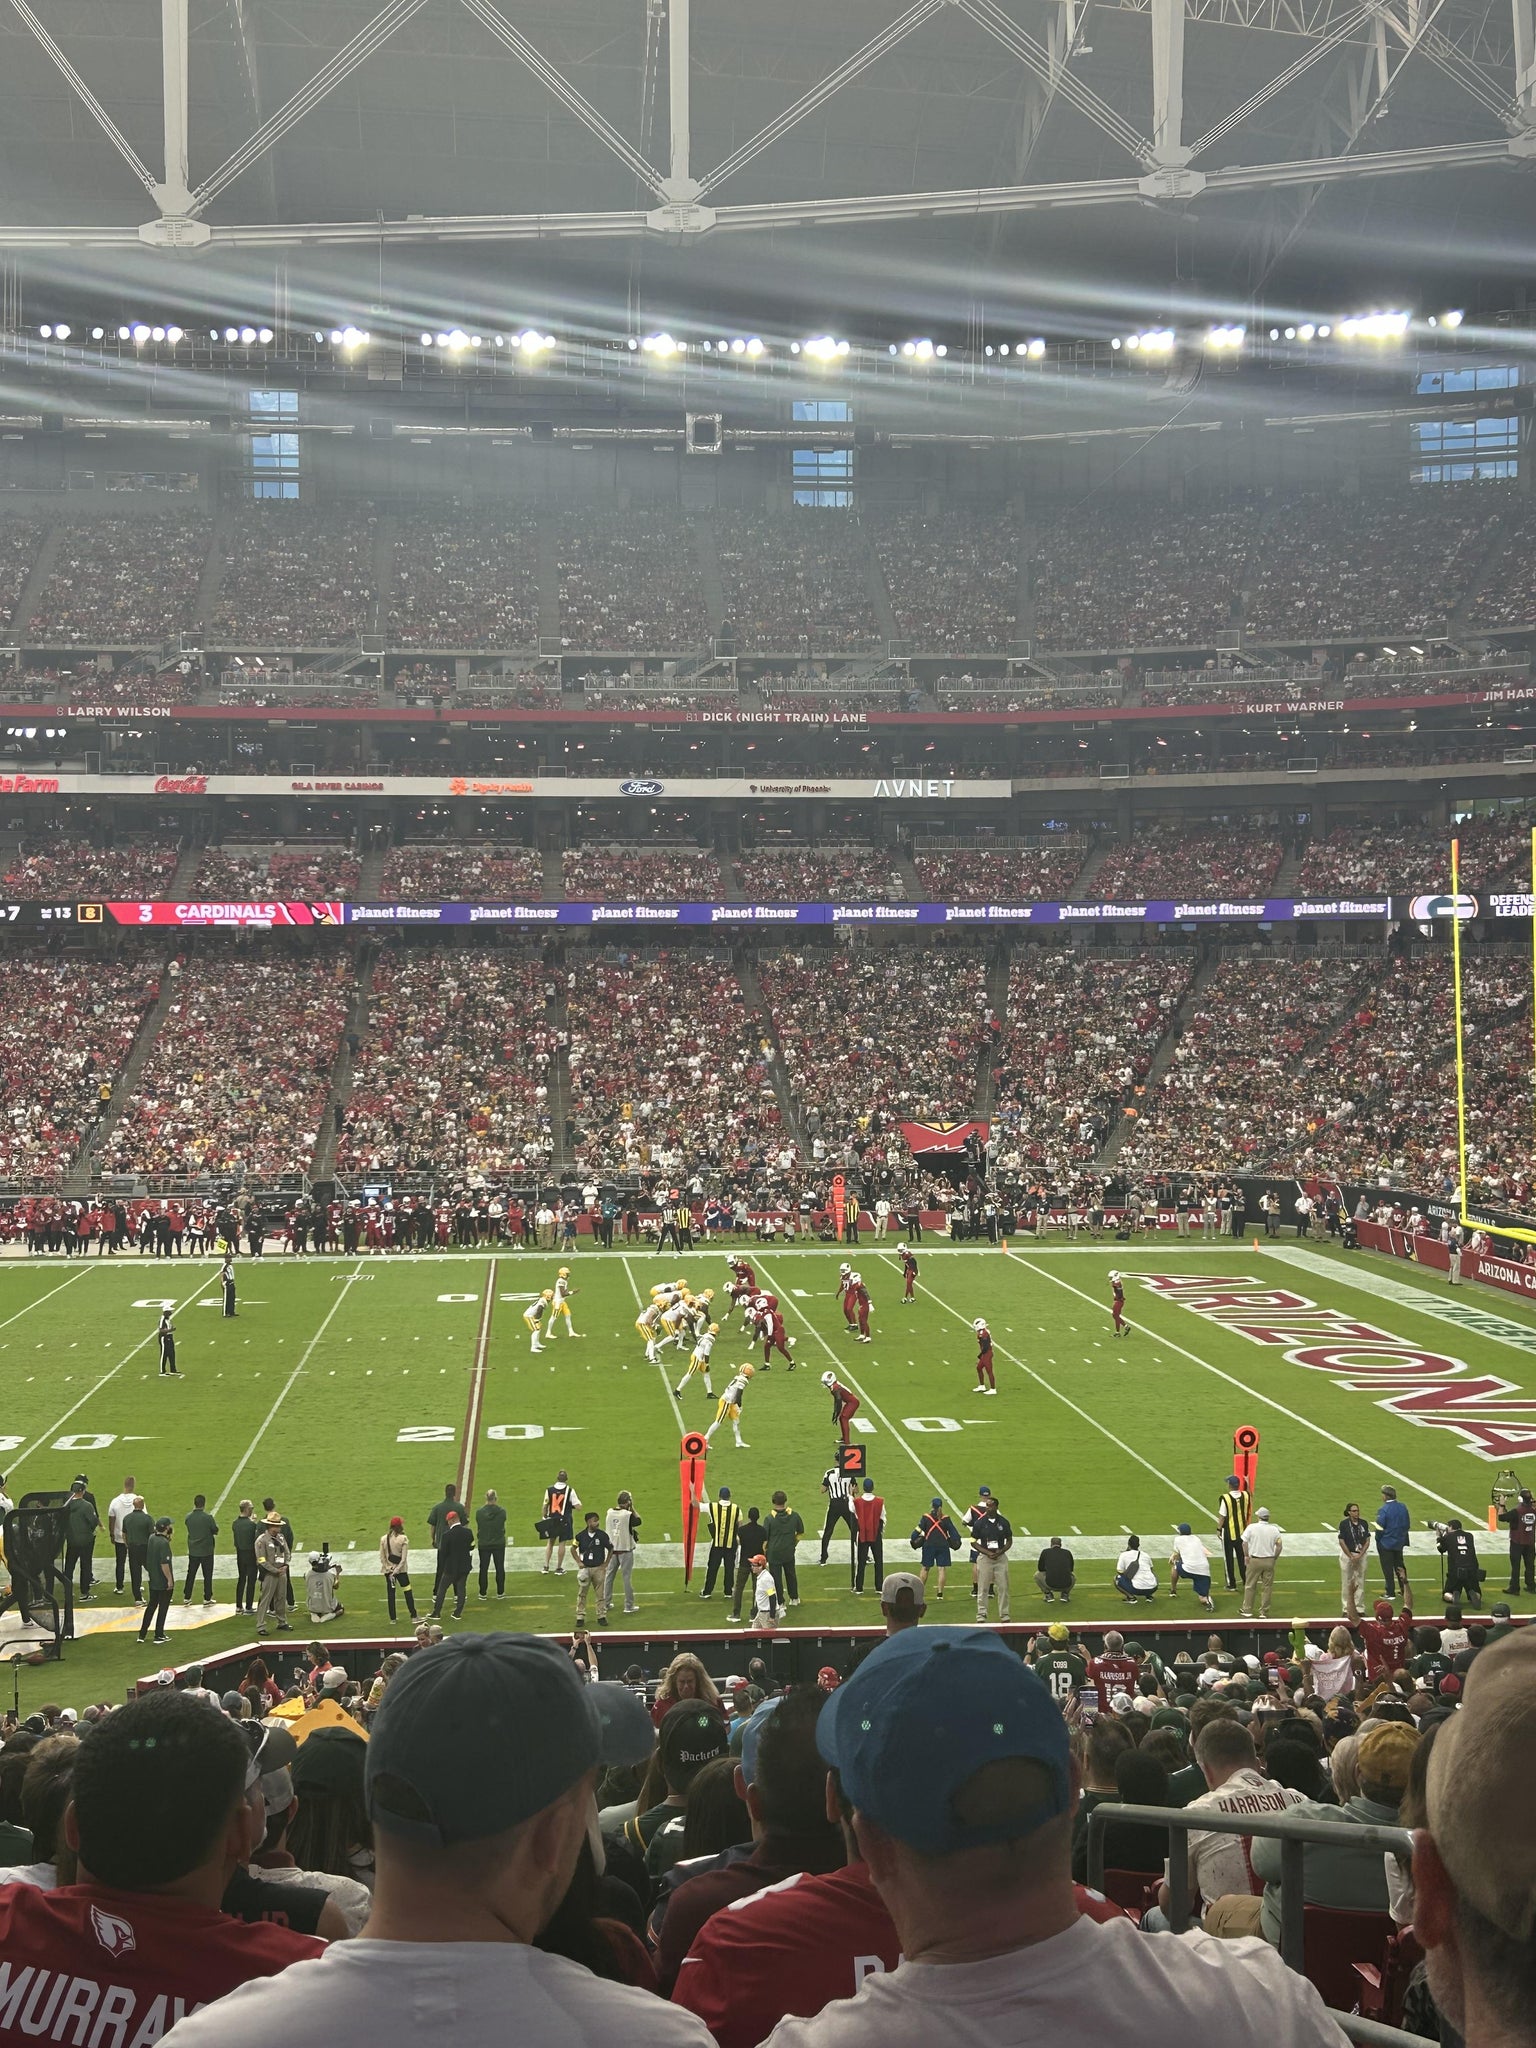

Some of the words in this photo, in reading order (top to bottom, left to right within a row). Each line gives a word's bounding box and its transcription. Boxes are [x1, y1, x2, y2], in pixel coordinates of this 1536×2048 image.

[1483, 691, 1503, 701] JIM
[57, 707, 64, 716] 8
[68, 707, 112, 716] LARRY
[117, 707, 171, 717] WILSON
[1247, 703, 1282, 713] KURT
[1287, 701, 1344, 712] WARNER
[703, 712, 732, 722] DICK
[736, 713, 780, 722] (NIGHT
[785, 713, 829, 723] TRAIN)
[833, 713, 867, 723] LANE
[14, 776, 59, 793] Farm
[292, 782, 313, 790] GILA
[315, 782, 342, 790] RIVER
[344, 782, 384, 791] CASINOS
[628, 781, 656, 794] Ford
[760, 785, 793, 794] University
[873, 780, 955, 797] AVNET
[55, 907, 72, 919] 13
[85, 907, 96, 919] 8
[138, 904, 153, 922] 3
[175, 905, 276, 919] CARDINALS
[351, 906, 395, 921] planet
[396, 906, 442, 919] fitness
[470, 906, 512, 921] planet
[514, 906, 559, 919] fitness
[592, 906, 633, 921] planet
[634, 906, 679, 919] fitness
[712, 907, 752, 921] planet
[754, 906, 798, 919] fitness
[833, 907, 873, 921] planet
[875, 906, 919, 919] fitness
[946, 906, 986, 920] planet
[988, 906, 1032, 918] fitness
[1059, 906, 1100, 919] planet
[1102, 905, 1147, 917] fitness
[1174, 904, 1217, 918] planet
[1219, 903, 1265, 916] fitness
[1293, 903, 1338, 917] planet
[1339, 902, 1387, 915] fitness
[670, 1190, 679, 1199] 2
[1478, 1261, 1521, 1286] ARIZONA
[1121, 1272, 1536, 1462] ARIZONA
[844, 1448, 862, 1469] 2
[551, 1493, 565, 1515] K
[1049, 1672, 1073, 1700] 18
[680, 1746, 720, 1762] Packers
[1218, 1792, 1287, 1814] HARRISON
